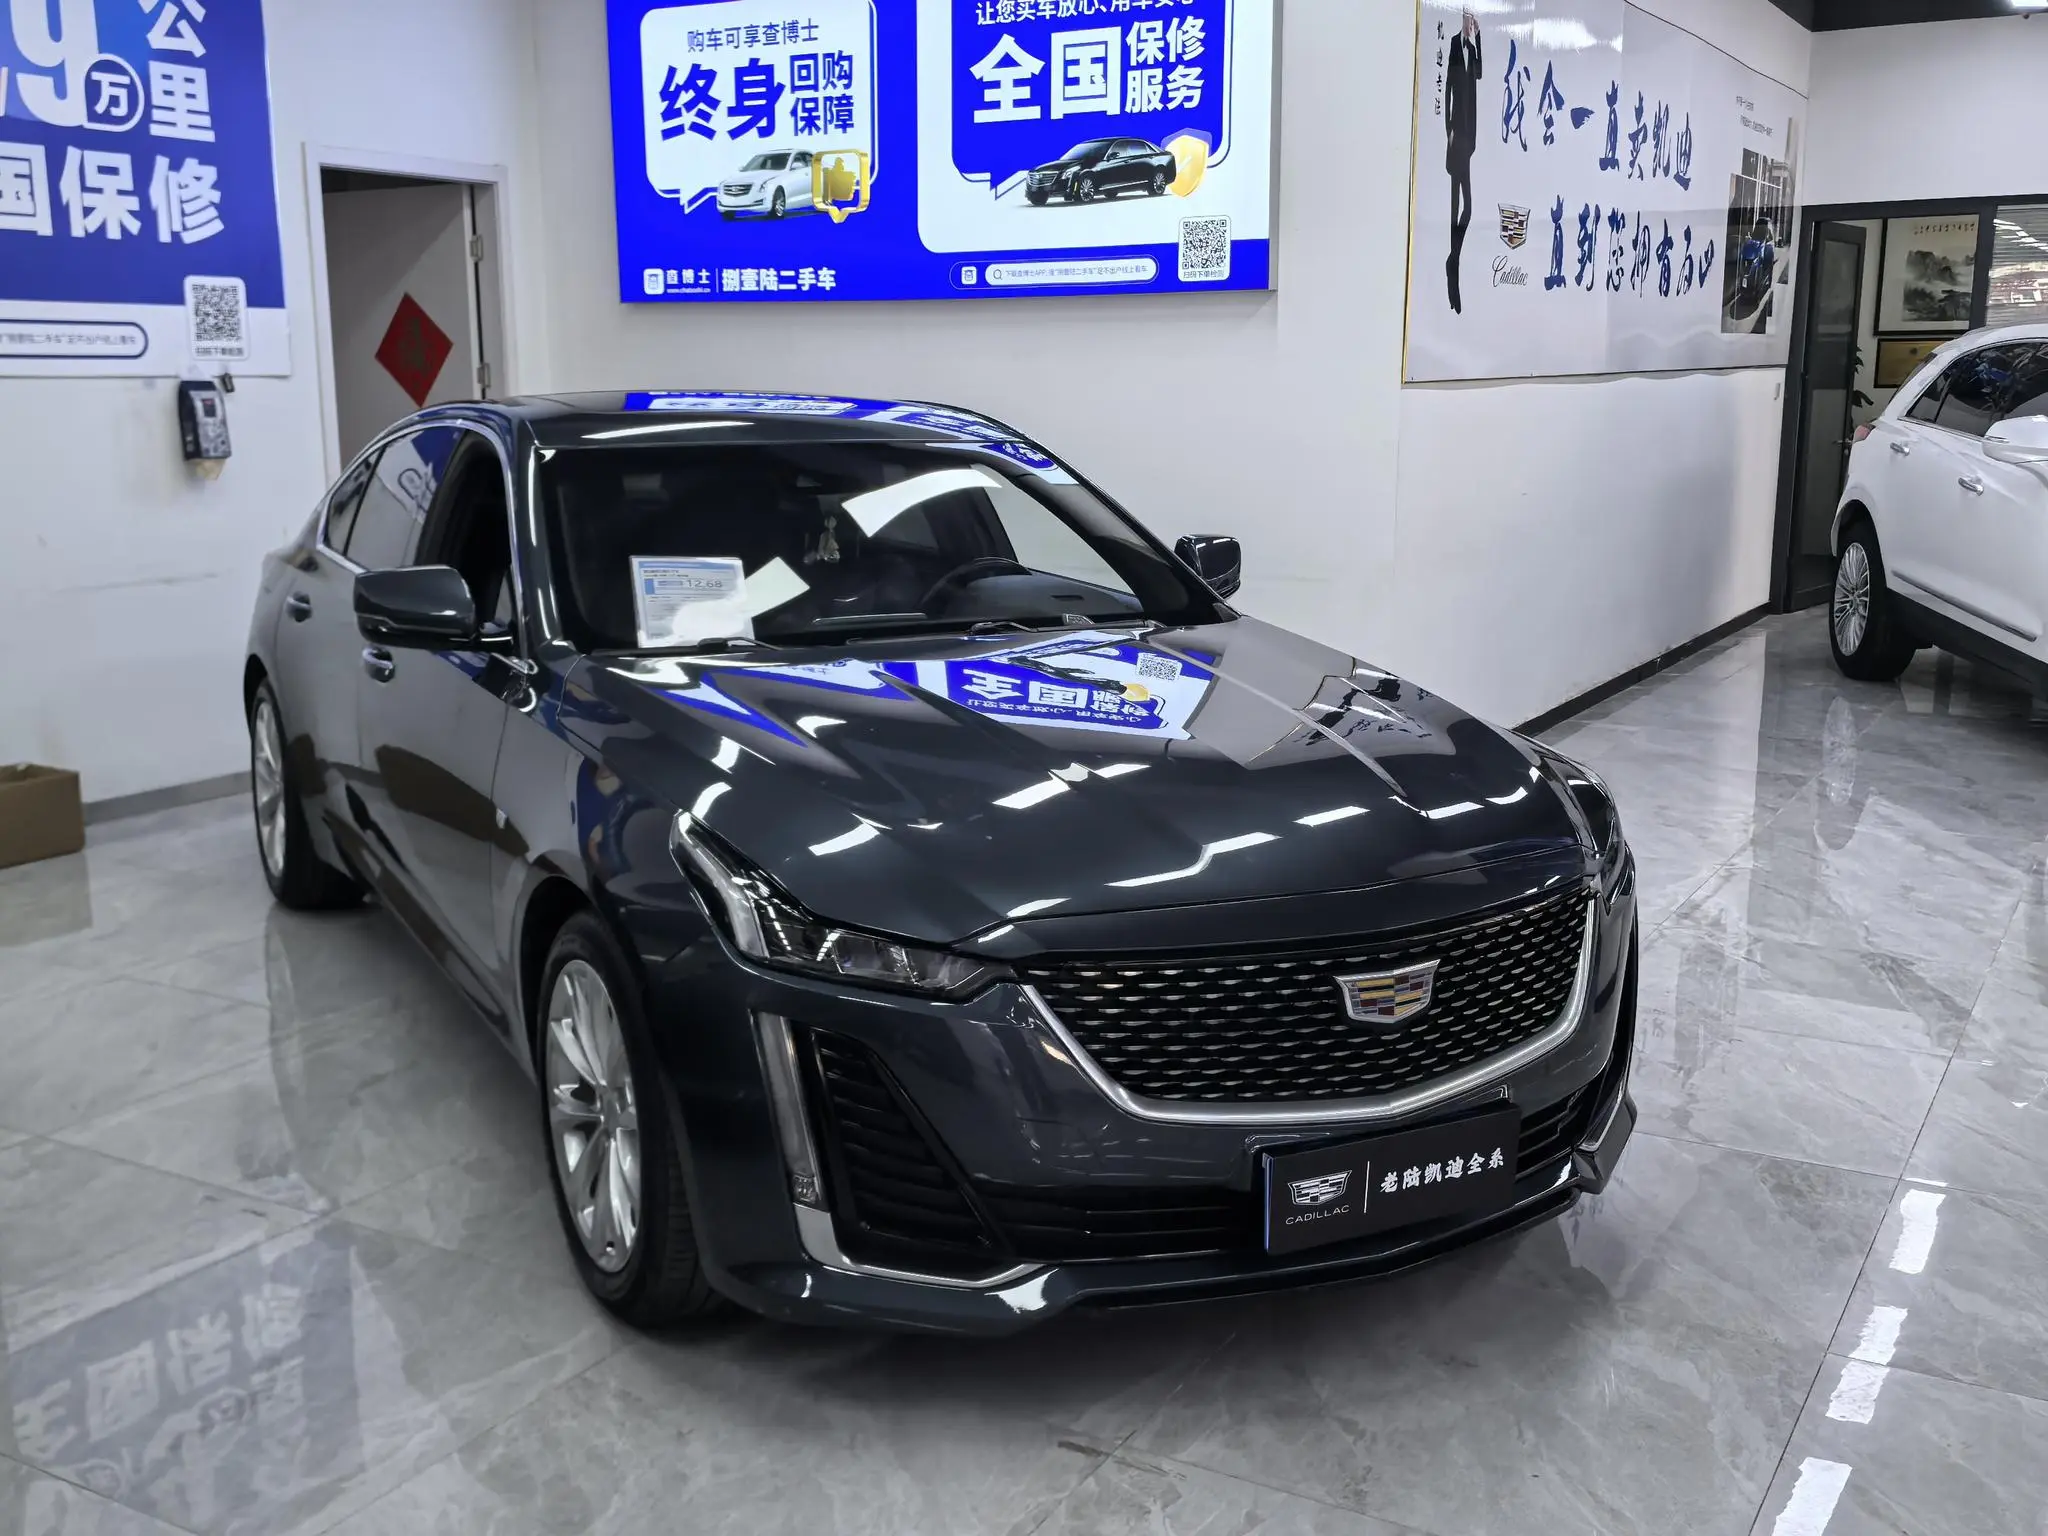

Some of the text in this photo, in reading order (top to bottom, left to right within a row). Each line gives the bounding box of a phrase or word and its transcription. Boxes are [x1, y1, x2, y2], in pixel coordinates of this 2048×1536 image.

[687, 18, 820, 53] 购车可享查博士
[1125, 15, 1207, 66] 保修
[90, 71, 131, 118] 万
[789, 50, 855, 94] 回购
[969, 26, 1122, 123] 全国
[1124, 65, 1206, 114] 服务
[659, 57, 786, 141] 终身
[789, 94, 855, 137] 保障
[1501, 39, 1692, 191] 我会一直卖凯迪
[666, 268, 711, 285] 查博士
[1491, 255, 1529, 288] Cadillac
[1379, 1147, 1504, 1194] 老陆凯迪全系
[1285, 1204, 1350, 1225] CADILLAC
